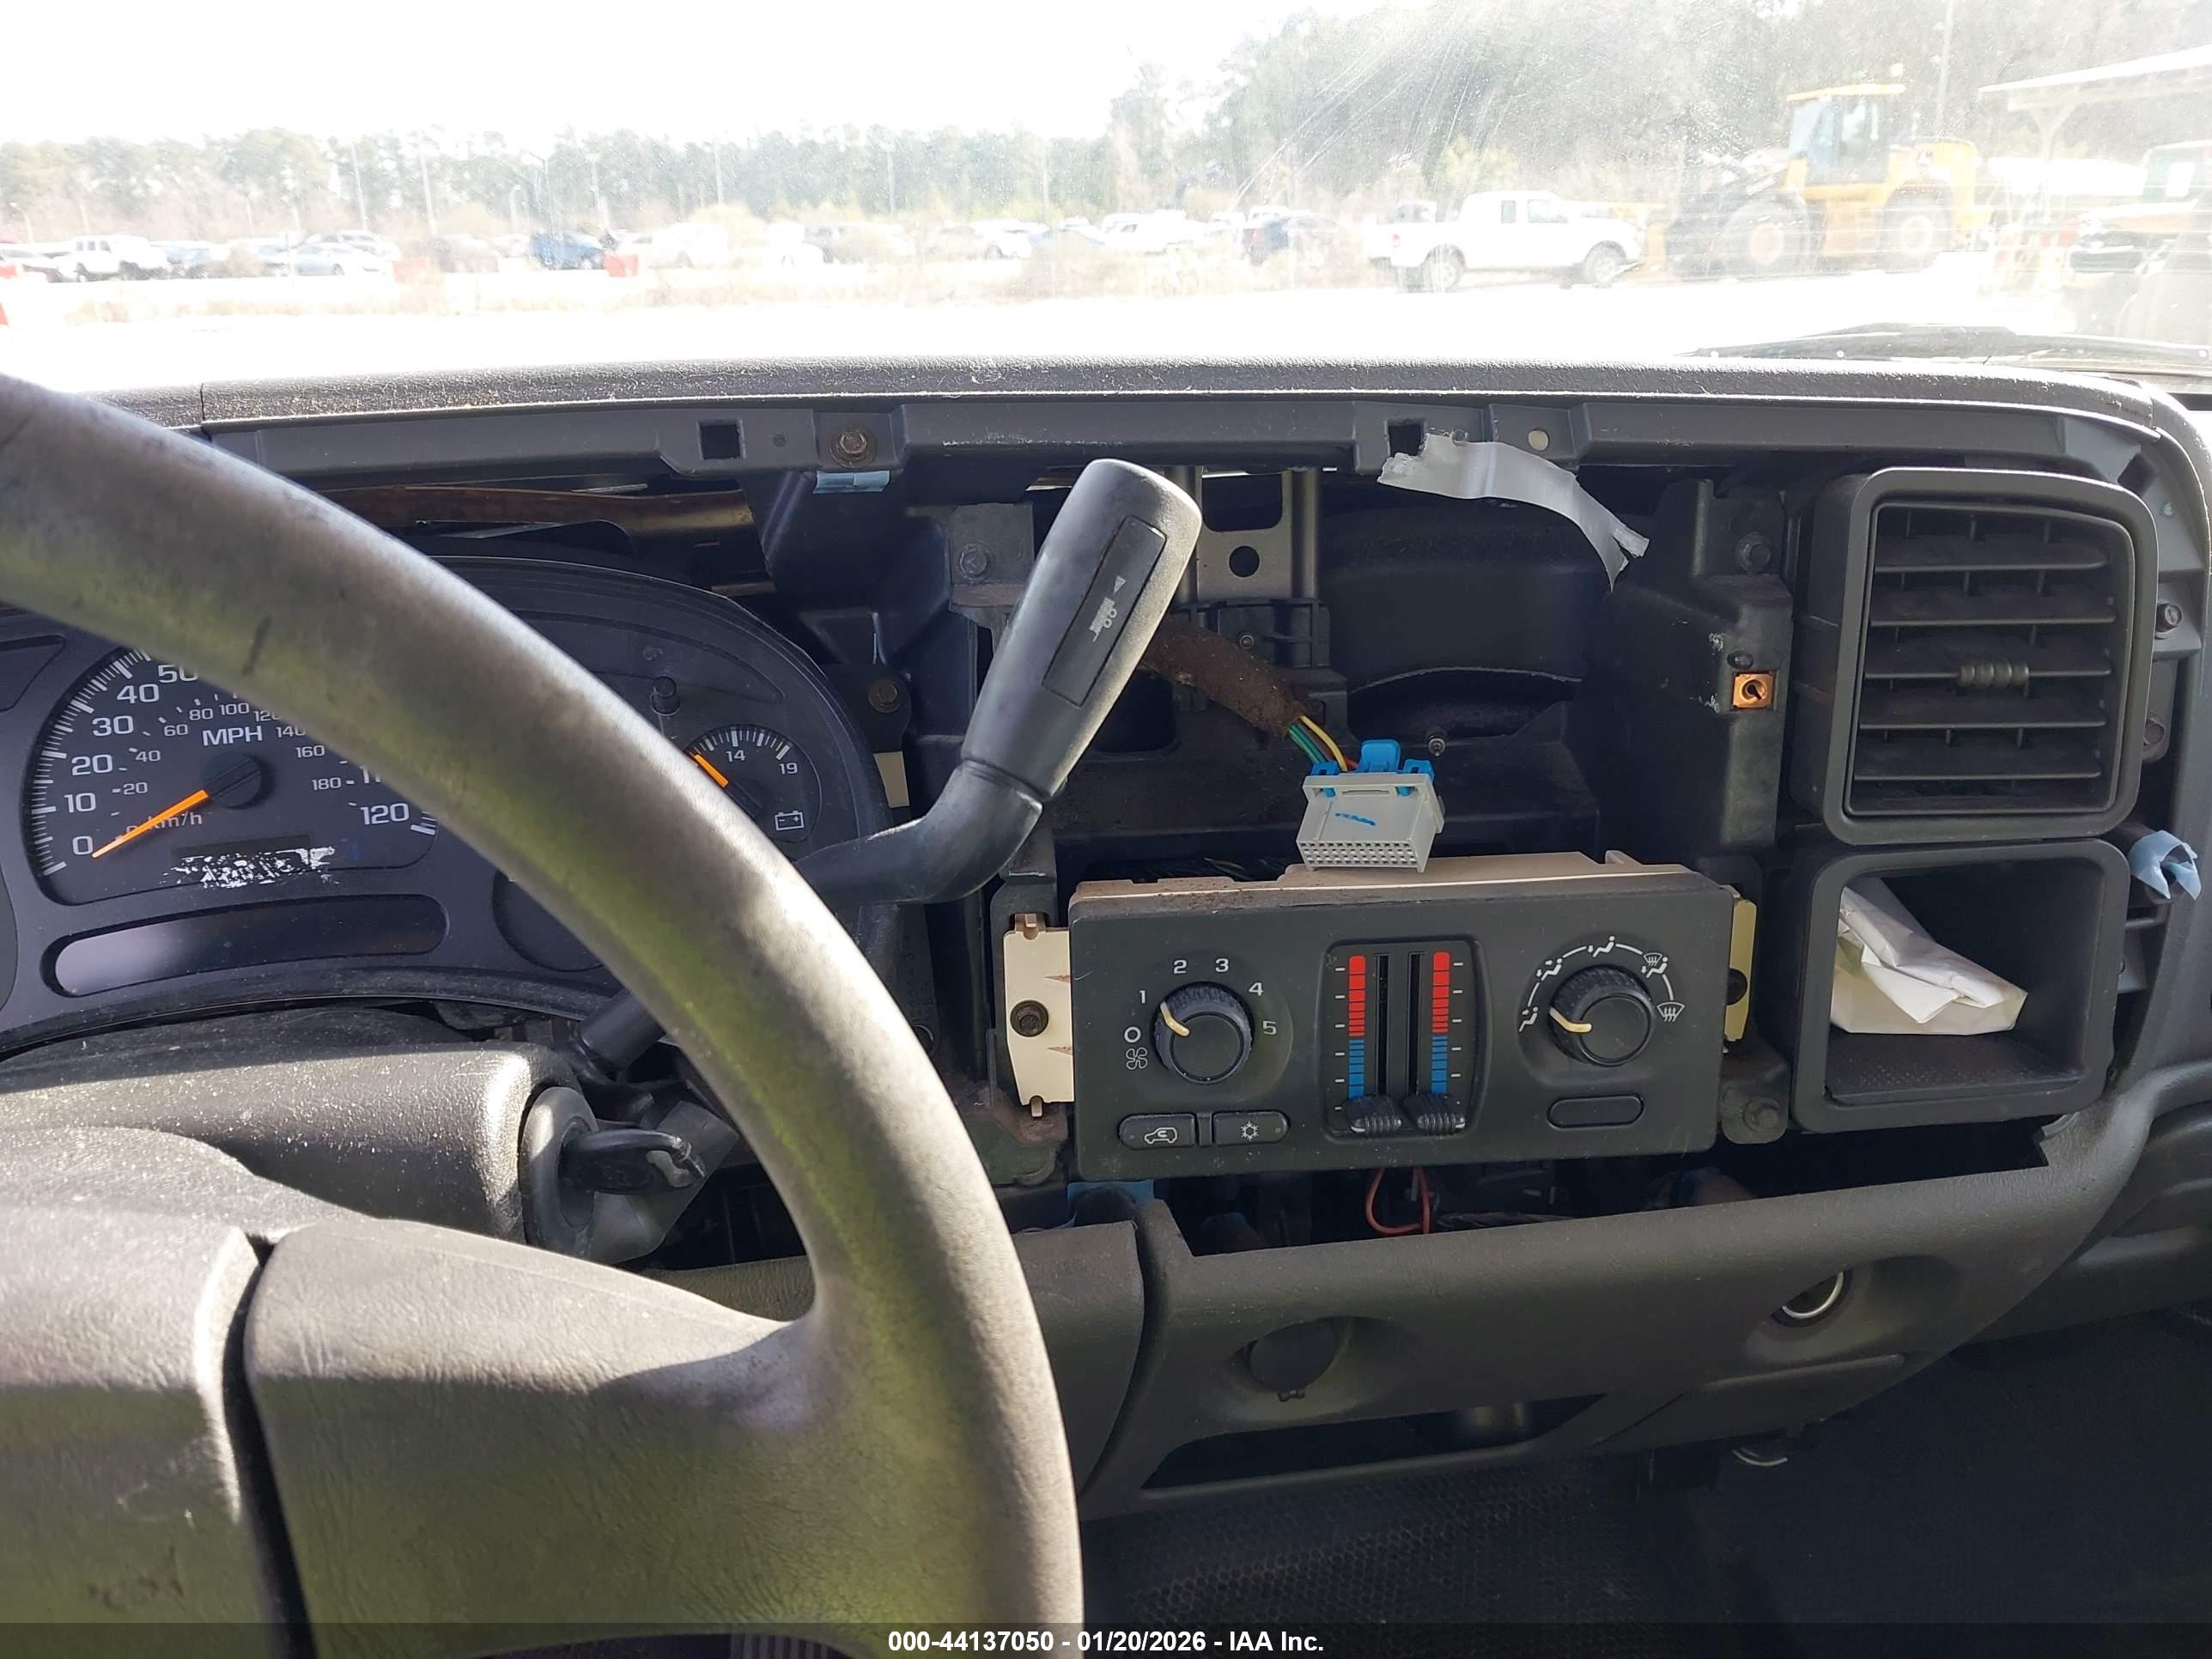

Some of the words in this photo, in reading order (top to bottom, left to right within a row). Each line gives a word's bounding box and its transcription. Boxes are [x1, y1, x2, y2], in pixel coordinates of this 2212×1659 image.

[117, 684, 160, 704] 40
[189, 708, 214, 721] 80
[219, 702, 250, 715] 100
[92, 715, 134, 737] 30
[164, 724, 188, 737] 60
[202, 726, 263, 746] MPH
[135, 750, 161, 763] 40
[295, 744, 325, 758] 160
[726, 750, 745, 763] 14
[70, 754, 113, 775] 20
[779, 762, 798, 775] 19
[123, 781, 149, 795] 20
[311, 777, 342, 791] 180
[64, 793, 96, 813] 10
[360, 802, 410, 824] 120
[72, 836, 94, 855] 0
[1173, 959, 1188, 975] 2
[1215, 957, 1230, 973] 3
[1249, 981, 1264, 996] 4
[1139, 989, 1146, 1004] 1
[1263, 1020, 1277, 1036] 5
